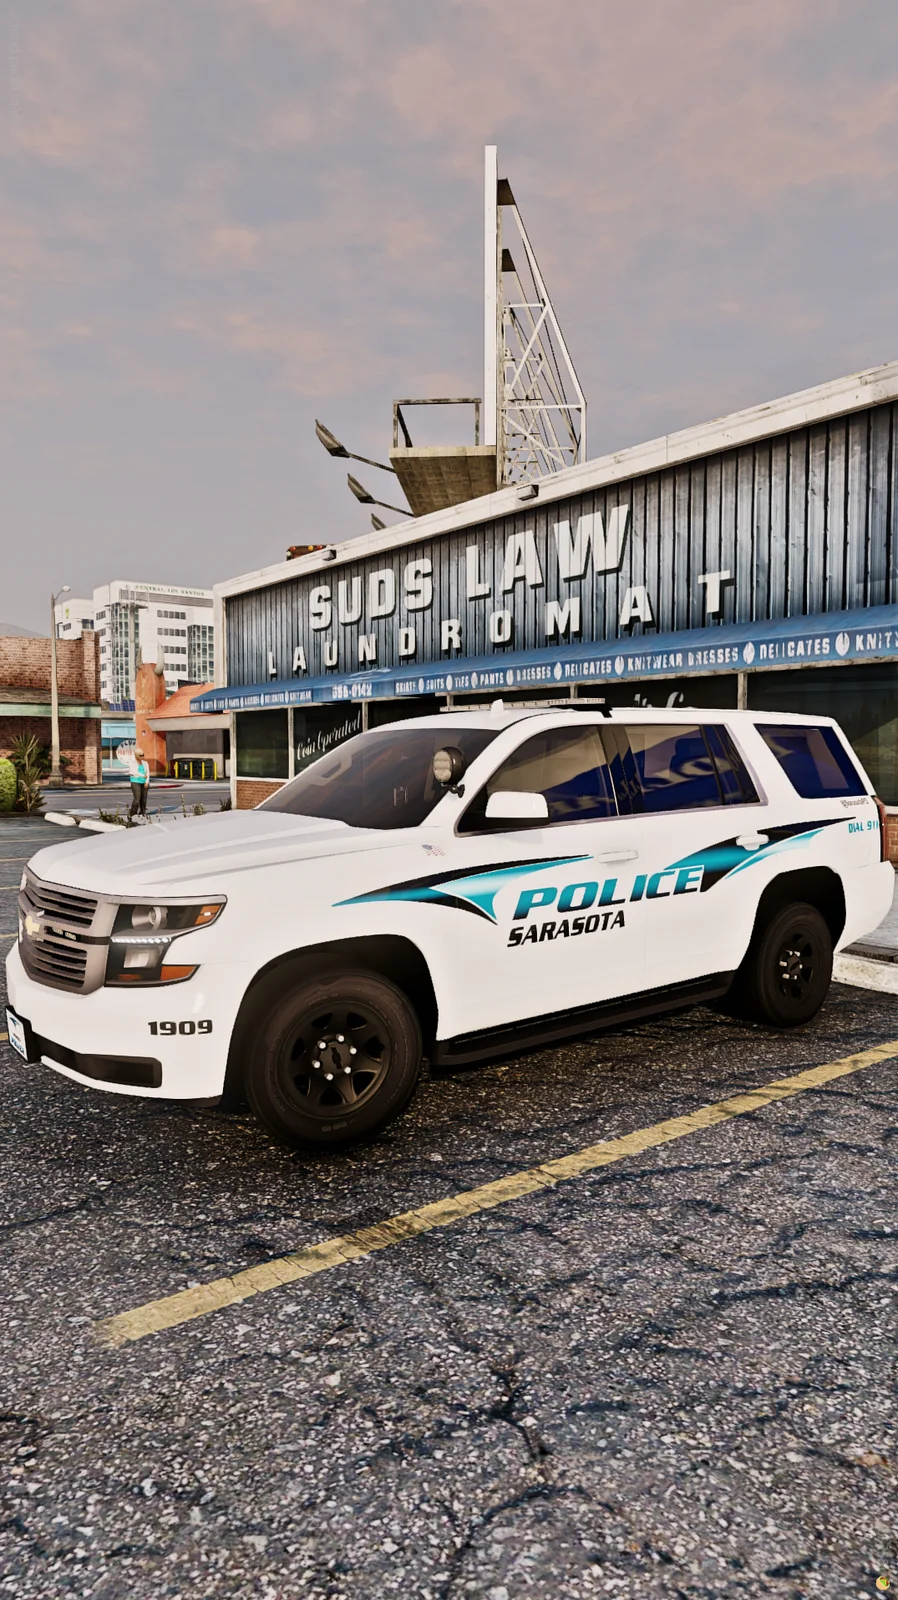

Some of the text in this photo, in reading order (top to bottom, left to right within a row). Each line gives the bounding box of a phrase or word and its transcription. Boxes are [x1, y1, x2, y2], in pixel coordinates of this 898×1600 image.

[309, 504, 629, 631] SUDS LAW
[135, 584, 164, 593] CENTRAL
[181, 589, 205, 597] SANTOS
[268, 571, 731, 676] LAUNDROMAT
[480, 672, 504, 686] PANTS
[627, 653, 683, 672] KNITWEAR
[688, 647, 739, 667] DRESSES
[848, 820, 879, 834] DIAL 911
[512, 865, 704, 921] POLICE
[507, 909, 626, 948] SARASOTA
[148, 1019, 213, 1036] 1909
